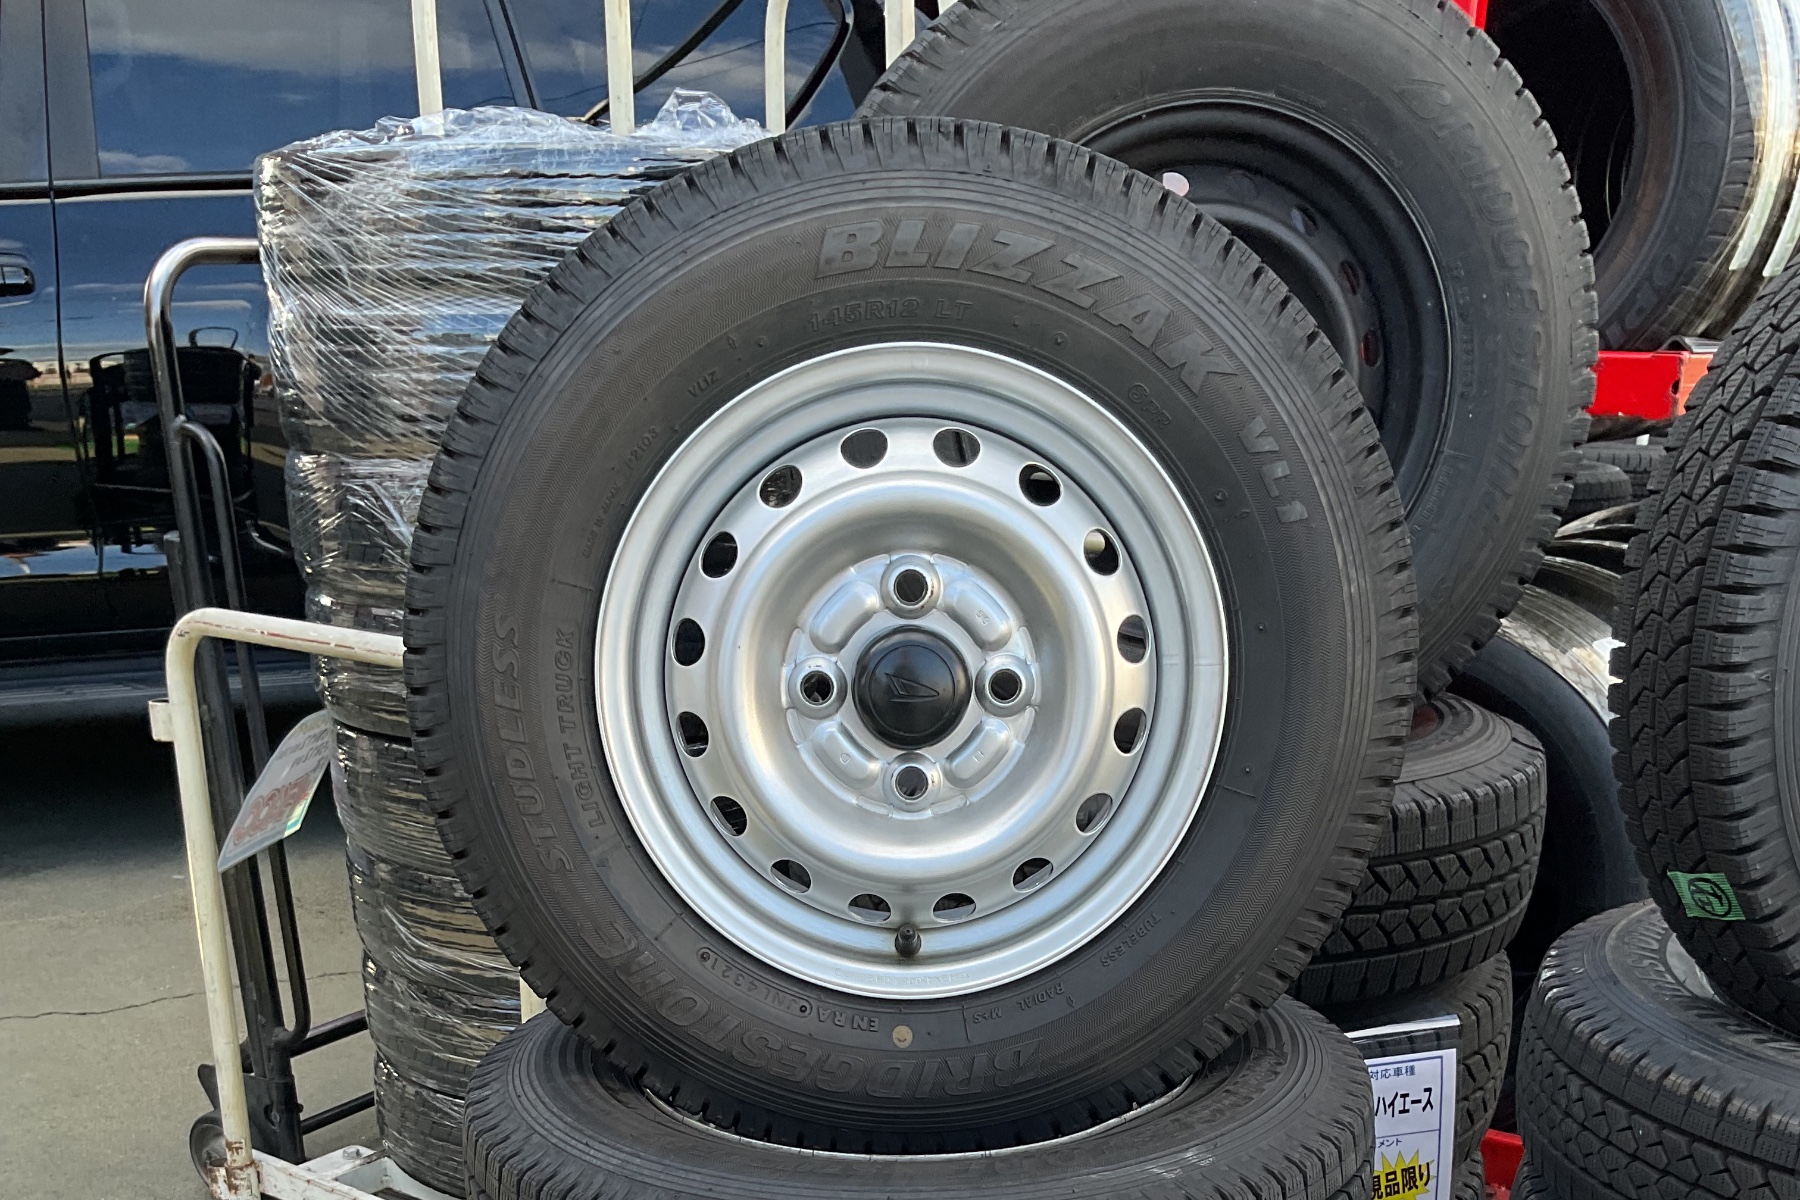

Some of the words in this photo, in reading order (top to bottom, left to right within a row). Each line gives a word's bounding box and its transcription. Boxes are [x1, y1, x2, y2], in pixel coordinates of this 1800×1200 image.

[808, 298, 919, 333] 145R12
[935, 299, 973, 321] LT
[815, 218, 1238, 398] BLIZZAK
[555, 627, 577, 734] TRUCK
[492, 612, 575, 873] STUDLESS
[563, 743, 607, 828] LIGHT
[1100, 912, 1162, 967] TUBELESS
[578, 919, 1043, 1099] BRIDGESTONE
[1017, 982, 1065, 1011] RADIAL
[1370, 1065, 1416, 1080] 対応車種
[1375, 1087, 1434, 1118] ハイエース
[1377, 1137, 1403, 1149] メント
